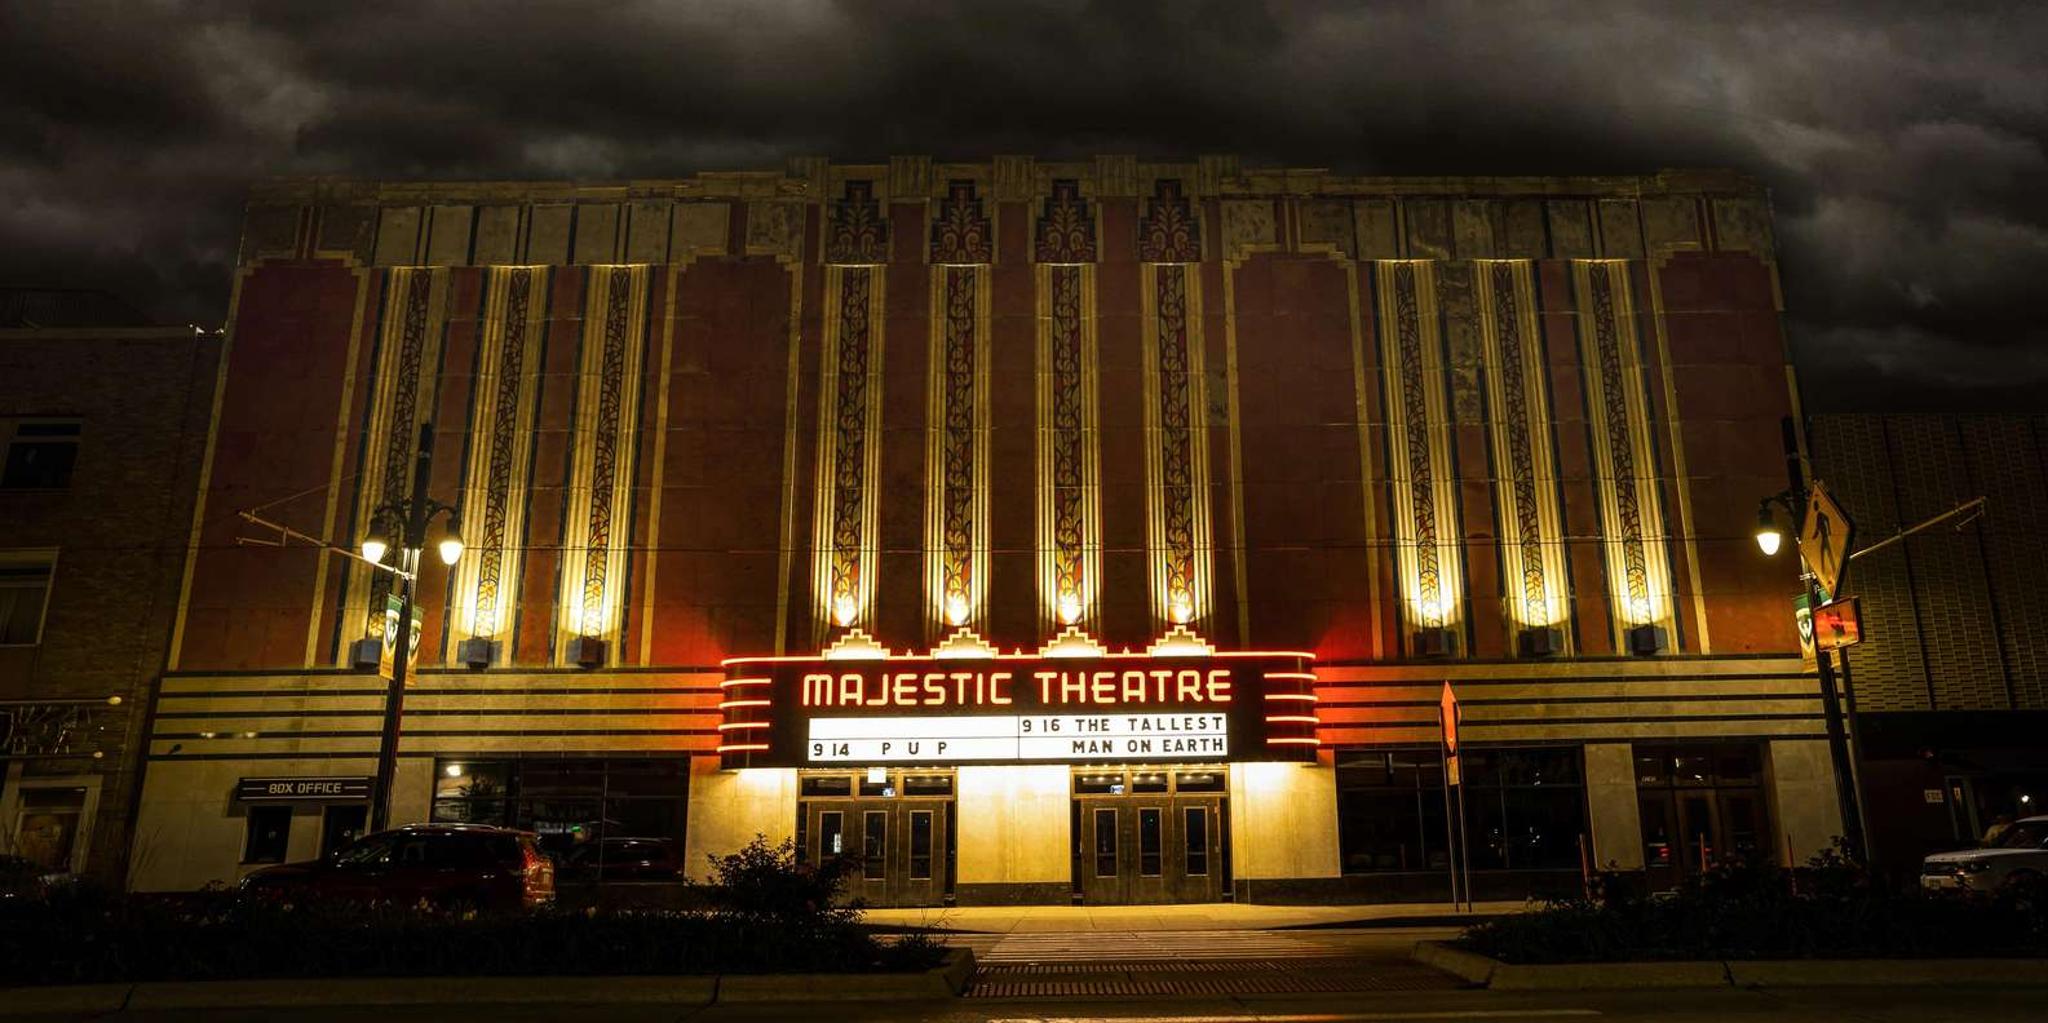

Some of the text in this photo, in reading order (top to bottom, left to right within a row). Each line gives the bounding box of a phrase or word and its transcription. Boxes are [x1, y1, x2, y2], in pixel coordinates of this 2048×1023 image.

[803, 670, 1232, 706] MAJESTIC THEATRE
[1022, 716, 1223, 733] 9 16 THE TALLEST
[814, 743, 823, 756] 9
[832, 743, 850, 756] 14
[1072, 738, 1223, 754] MAN ON EARTH
[269, 782, 342, 794] BOX OFFICE
